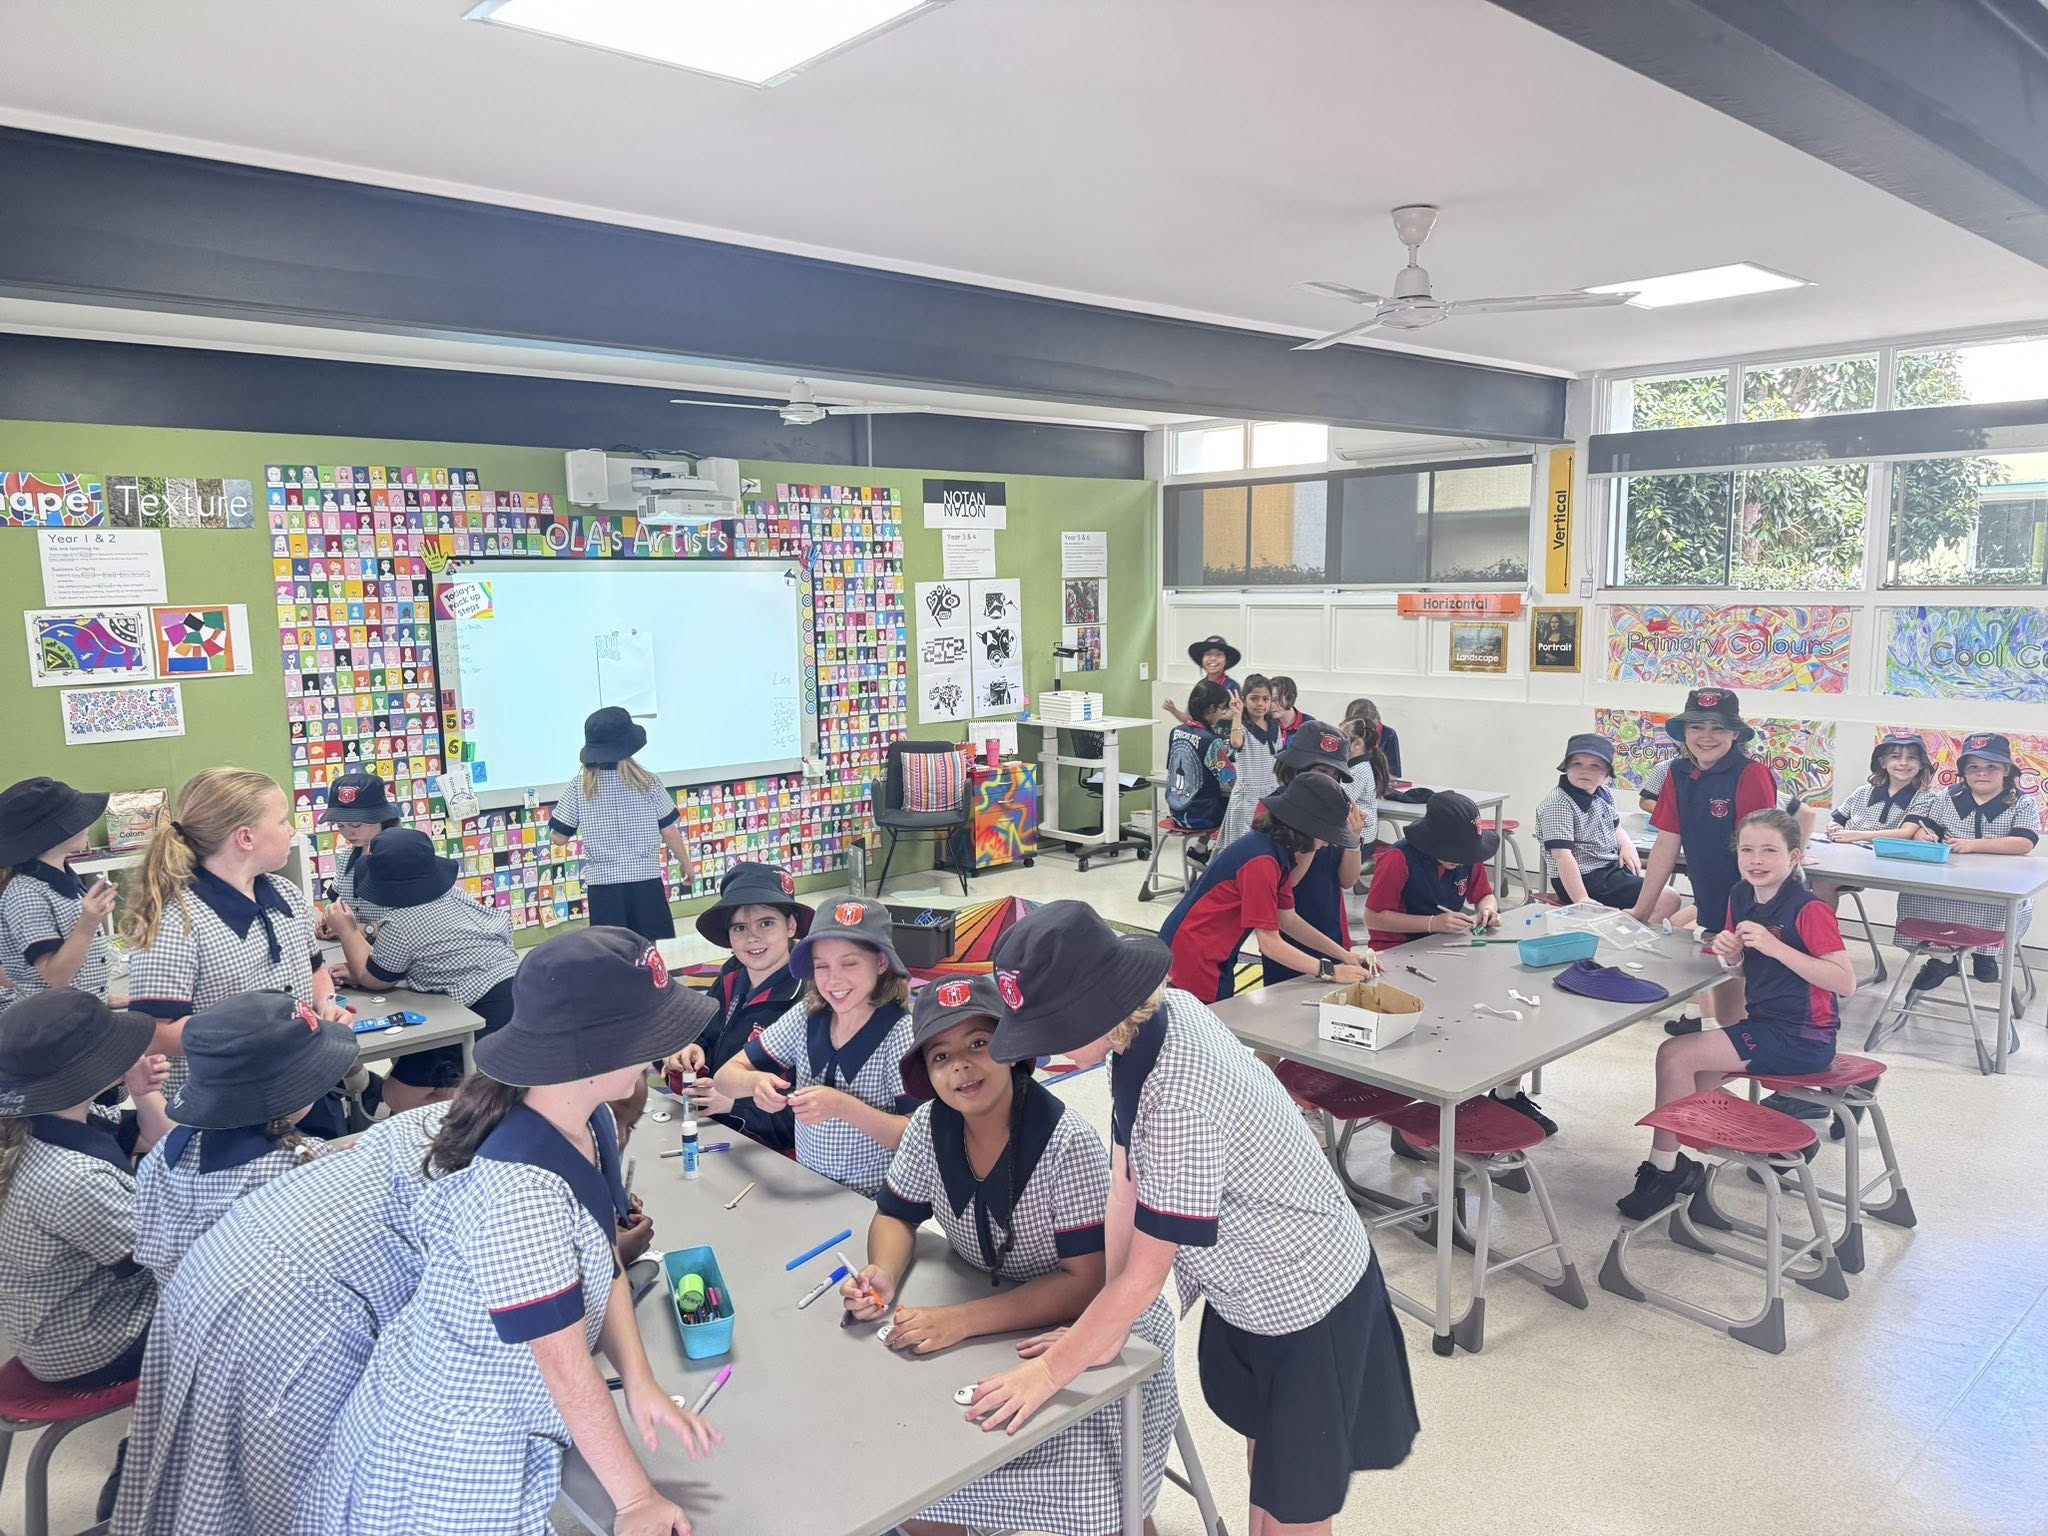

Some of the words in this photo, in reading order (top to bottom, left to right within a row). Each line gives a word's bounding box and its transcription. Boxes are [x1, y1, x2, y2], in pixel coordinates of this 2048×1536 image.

[115, 485, 248, 517] Texture
[943, 490, 986, 505] NOTAN
[1553, 490, 1568, 550] Vertical
[48, 534, 78, 543] Year
[85, 534, 88, 543] 1
[95, 534, 104, 543] &
[108, 534, 116, 543] 2
[545, 520, 623, 552] OLA's
[633, 521, 728, 554] Artists
[444, 584, 476, 602] Today's
[448, 596, 469, 611] Pack
[470, 593, 481, 602] up
[1423, 598, 1488, 610] Horizontal
[1538, 642, 1573, 652] Portrait
[1627, 631, 1719, 657] Primary
[1728, 632, 1834, 656] Colours
[1456, 653, 1499, 662] Landscape
[1930, 641, 2003, 668] Cool
[446, 714, 457, 729] 5
[463, 711, 474, 725] 3
[448, 740, 459, 754] 6
[1741, 1032, 1756, 1050] OLA
